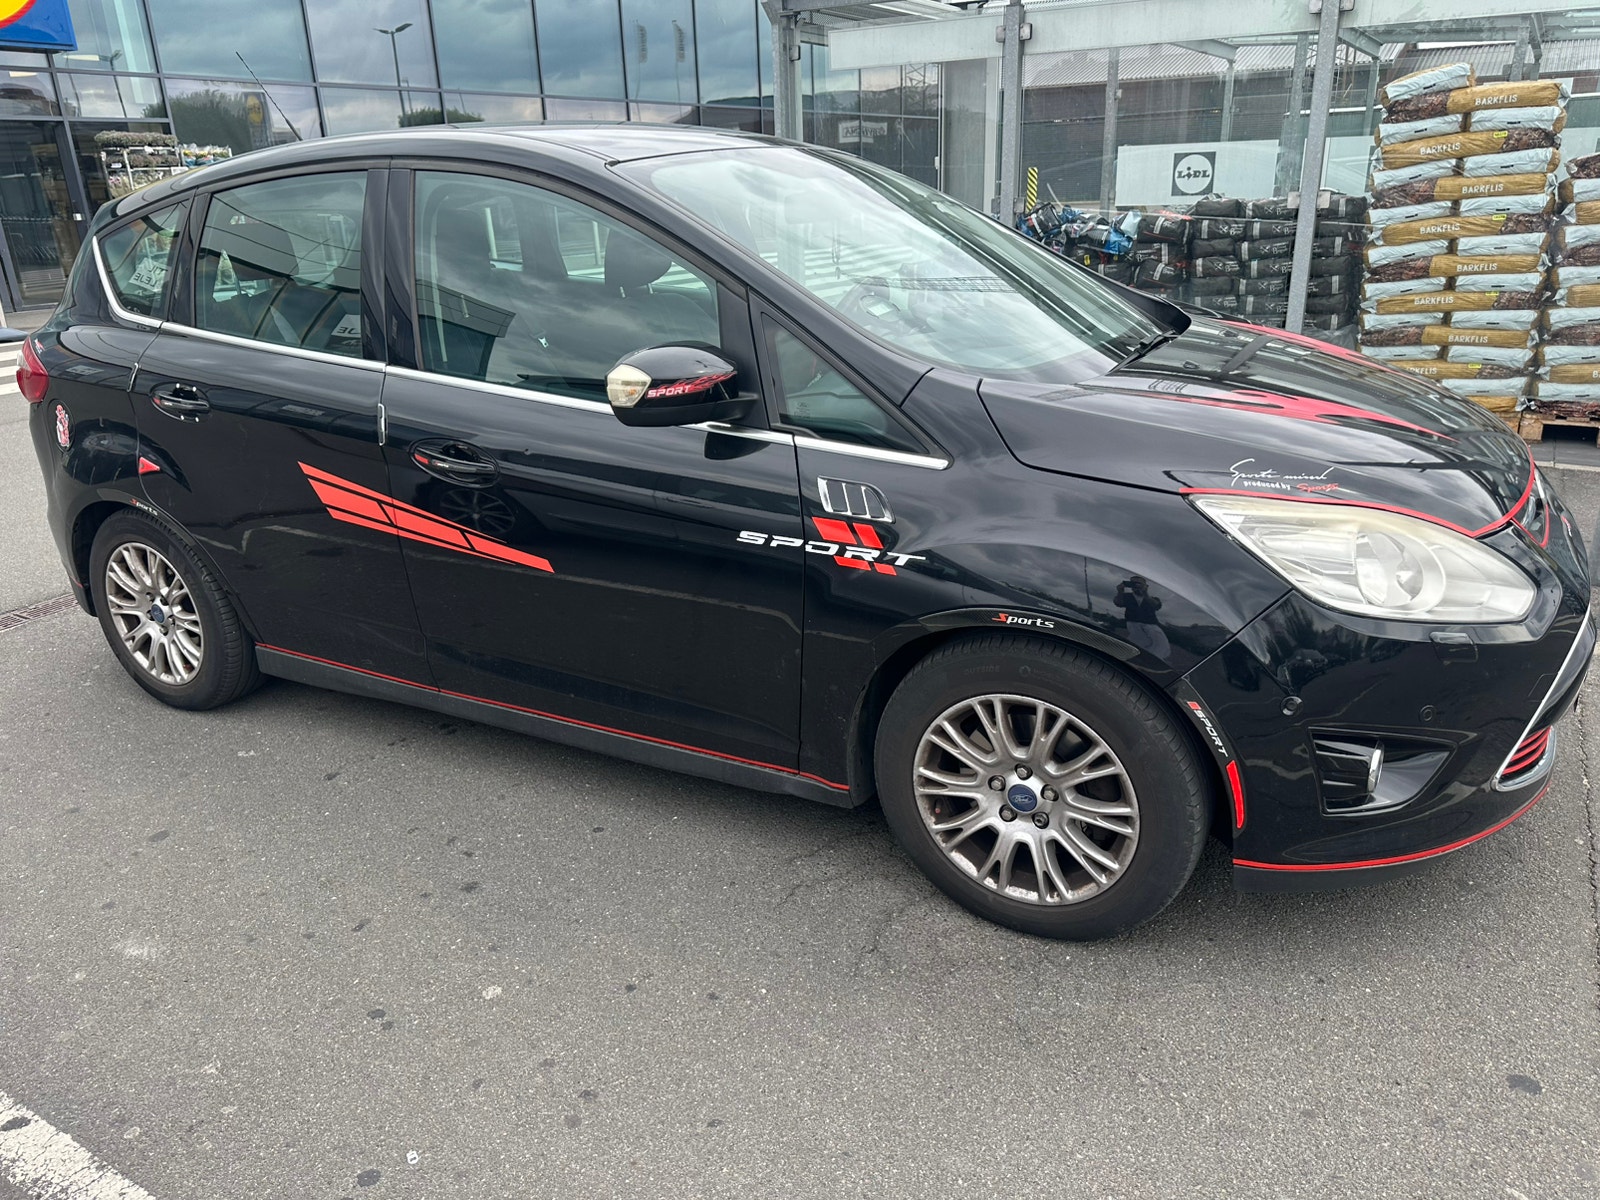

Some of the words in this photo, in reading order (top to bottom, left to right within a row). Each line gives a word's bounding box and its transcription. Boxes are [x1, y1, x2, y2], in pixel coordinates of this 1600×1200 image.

[1474, 94, 1518, 106] BARKFLIS
[1419, 142, 1461, 156] BARKFLIS
[1461, 183, 1504, 194] BARKFLIS
[1419, 223, 1461, 235] BARKFLIS
[1456, 263, 1498, 272] BARKFLIS
[1414, 296, 1454, 305] BARKFLIS
[1448, 334, 1489, 344] BARKFLIS
[647, 384, 691, 398] SPORT
[1229, 458, 1280, 487] Sports
[1243, 480, 1280, 489] produced
[1280, 482, 1291, 491] by
[736, 530, 926, 566] SPORT
[991, 612, 1055, 629] Sports
[1193, 709, 1229, 758] SPORT
